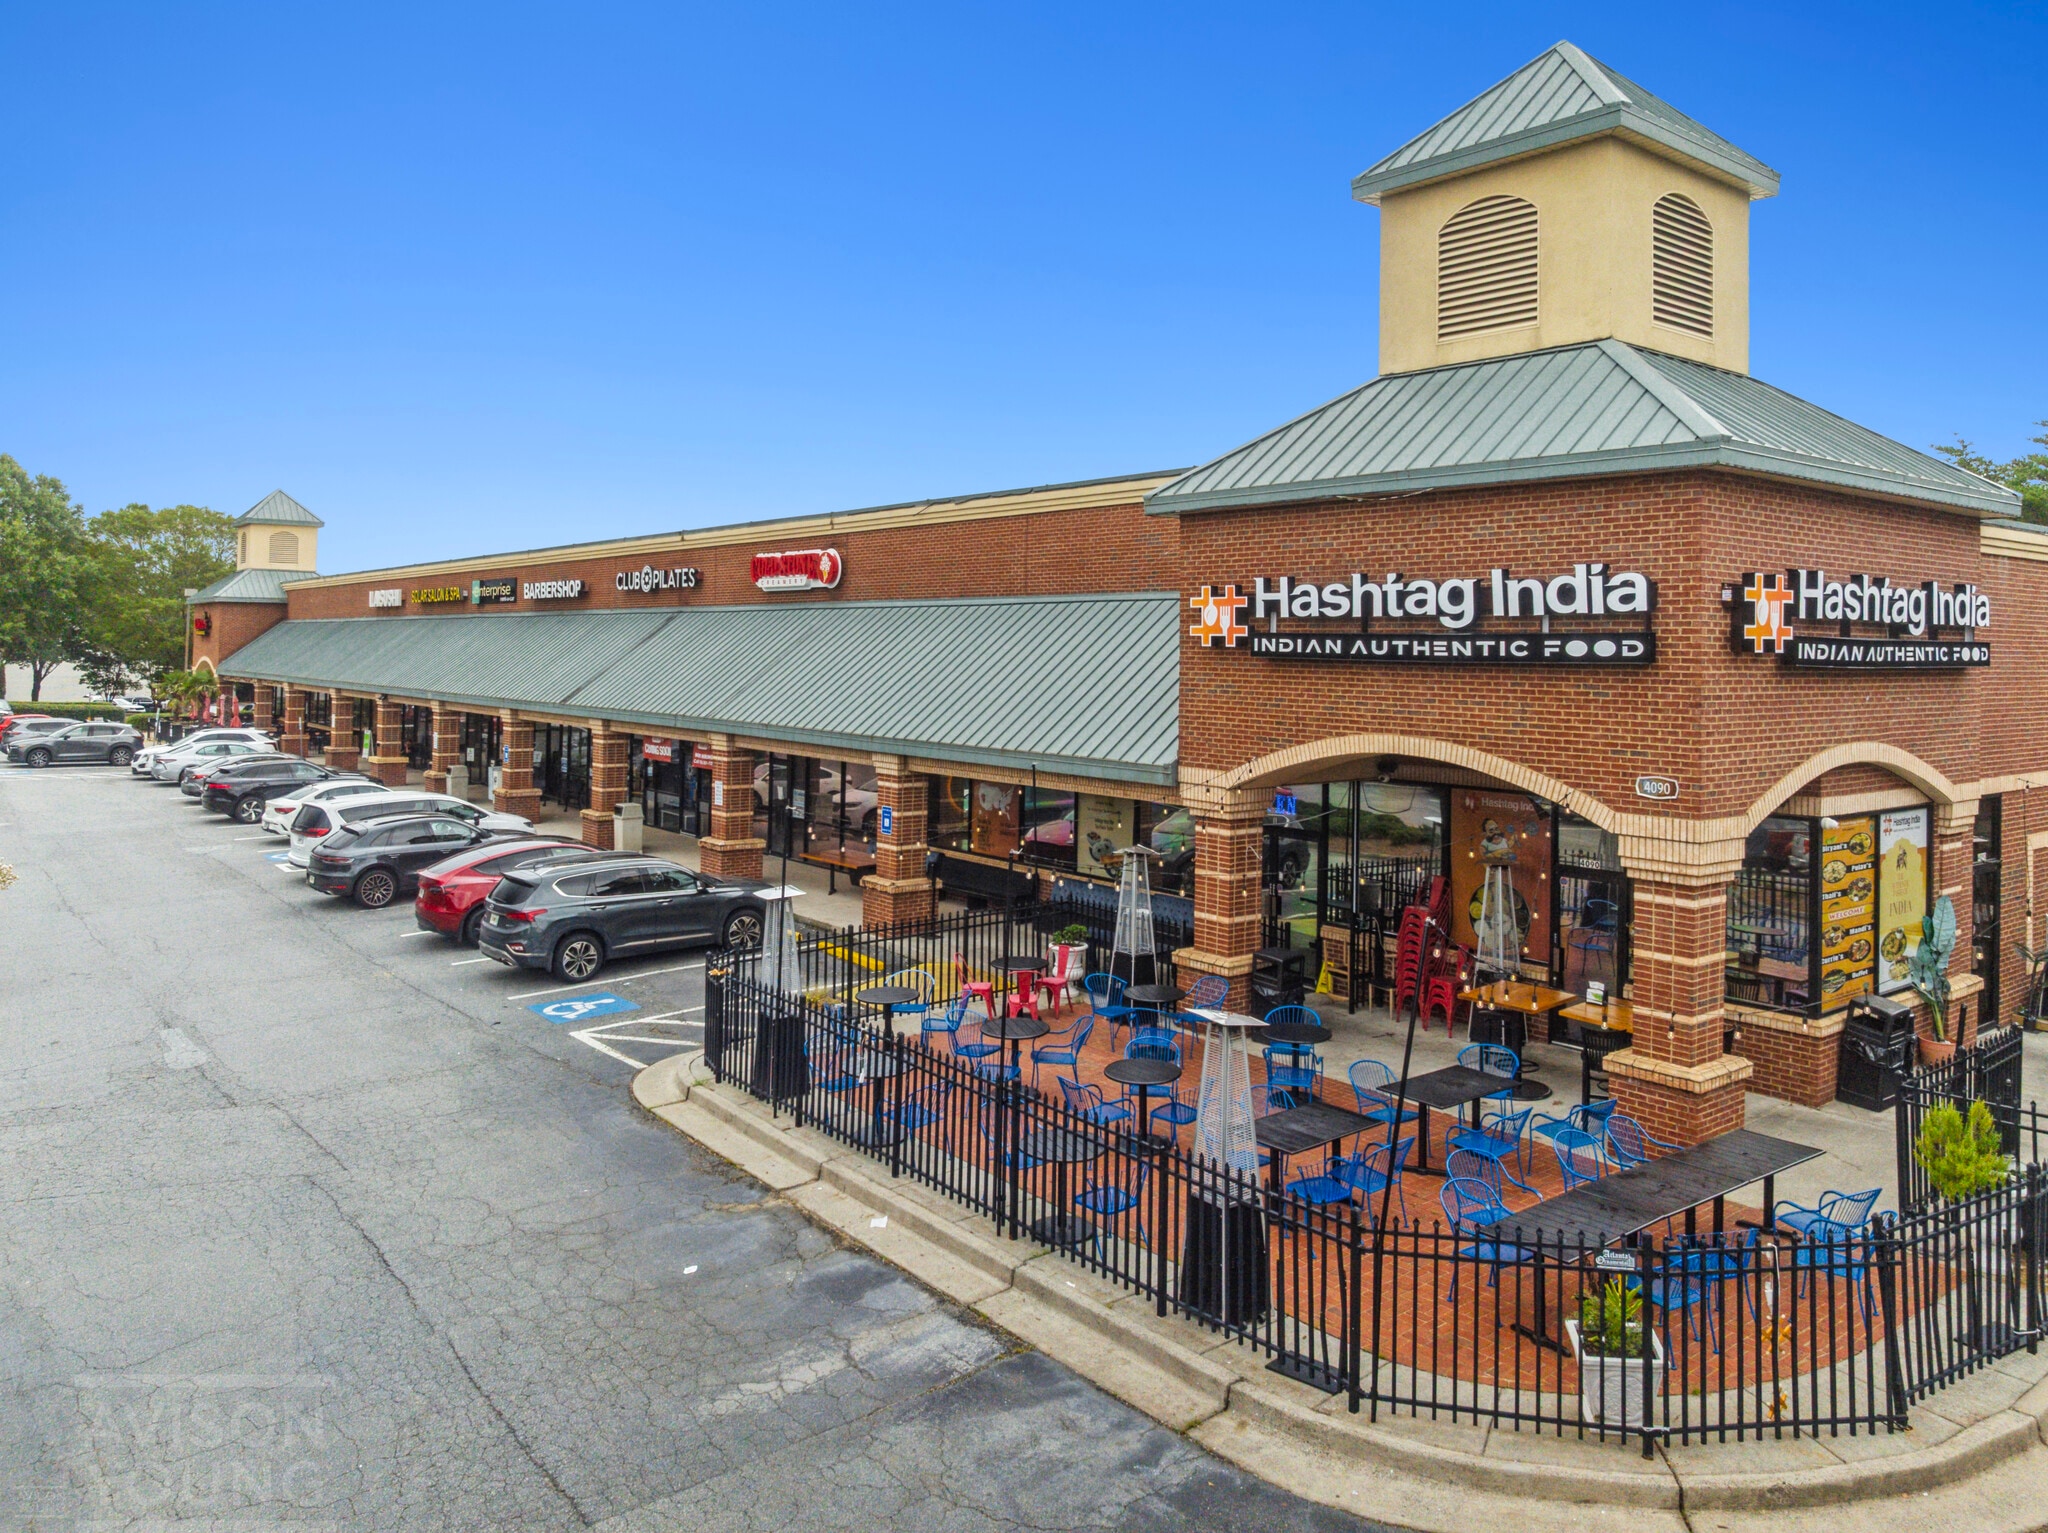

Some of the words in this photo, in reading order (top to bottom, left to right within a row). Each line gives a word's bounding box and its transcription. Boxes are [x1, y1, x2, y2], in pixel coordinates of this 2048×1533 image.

[616, 571, 641, 591] CLUB
[652, 567, 696, 589] PILATES
[473, 583, 511, 600] enterprise
[523, 580, 582, 599] BARBERSHOP
[1253, 573, 1479, 629] Hashtag
[1490, 563, 1648, 617] India
[1798, 569, 1928, 636] Hashtag
[1932, 581, 1990, 628] India
[1254, 638, 1341, 654] INDIAN
[1350, 639, 1529, 657] AUTHENTIC
[1544, 640, 1644, 657] FOOD
[1798, 643, 1865, 661] INDIAN
[1866, 646, 1949, 662] AUTHENTIC
[1953, 647, 1988, 661] FOOD
[1643, 781, 1671, 795] 4090
[1481, 797, 1519, 812] Hashtag
[1580, 859, 1600, 869] 4090
[1828, 906, 1864, 920] WELCOME
[1889, 900, 1912, 917] INDIA
[1851, 968, 1869, 979] Buffet
